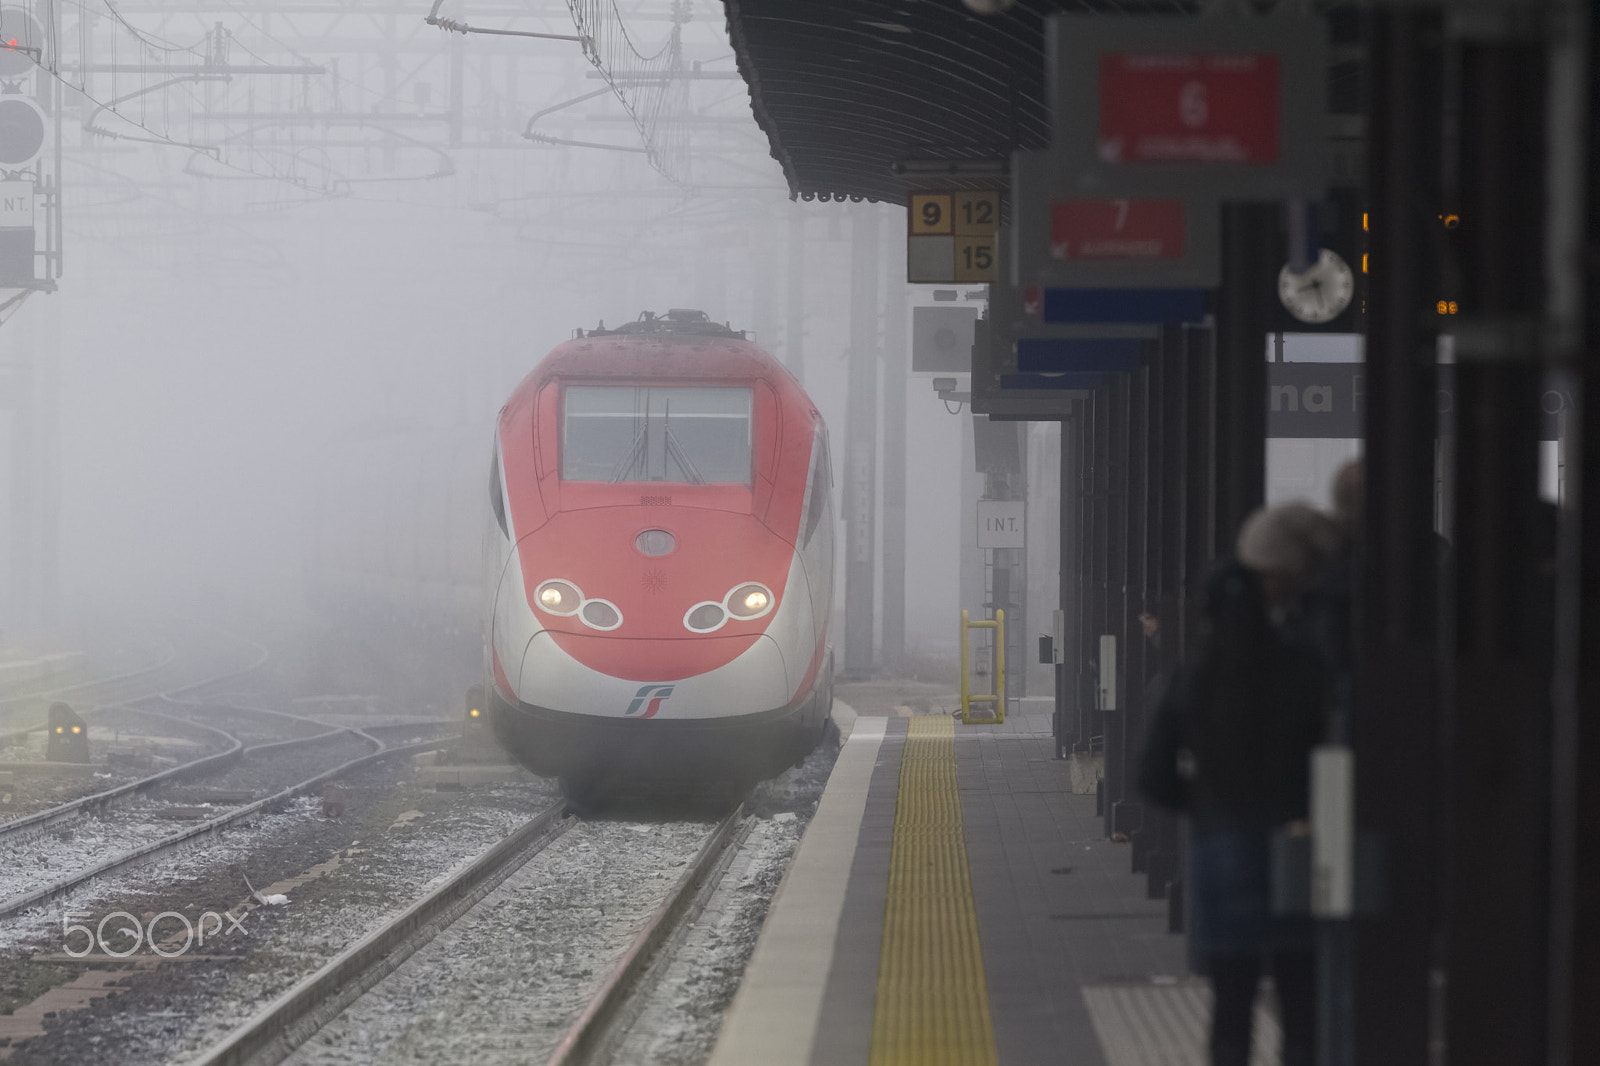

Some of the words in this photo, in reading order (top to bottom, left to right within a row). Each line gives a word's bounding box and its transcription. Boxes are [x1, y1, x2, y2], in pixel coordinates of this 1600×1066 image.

[1179, 80, 1209, 128] 6
[922, 202, 941, 226] 9
[962, 200, 993, 225] 12
[1111, 199, 1130, 231] 7
[962, 246, 993, 270] 15
